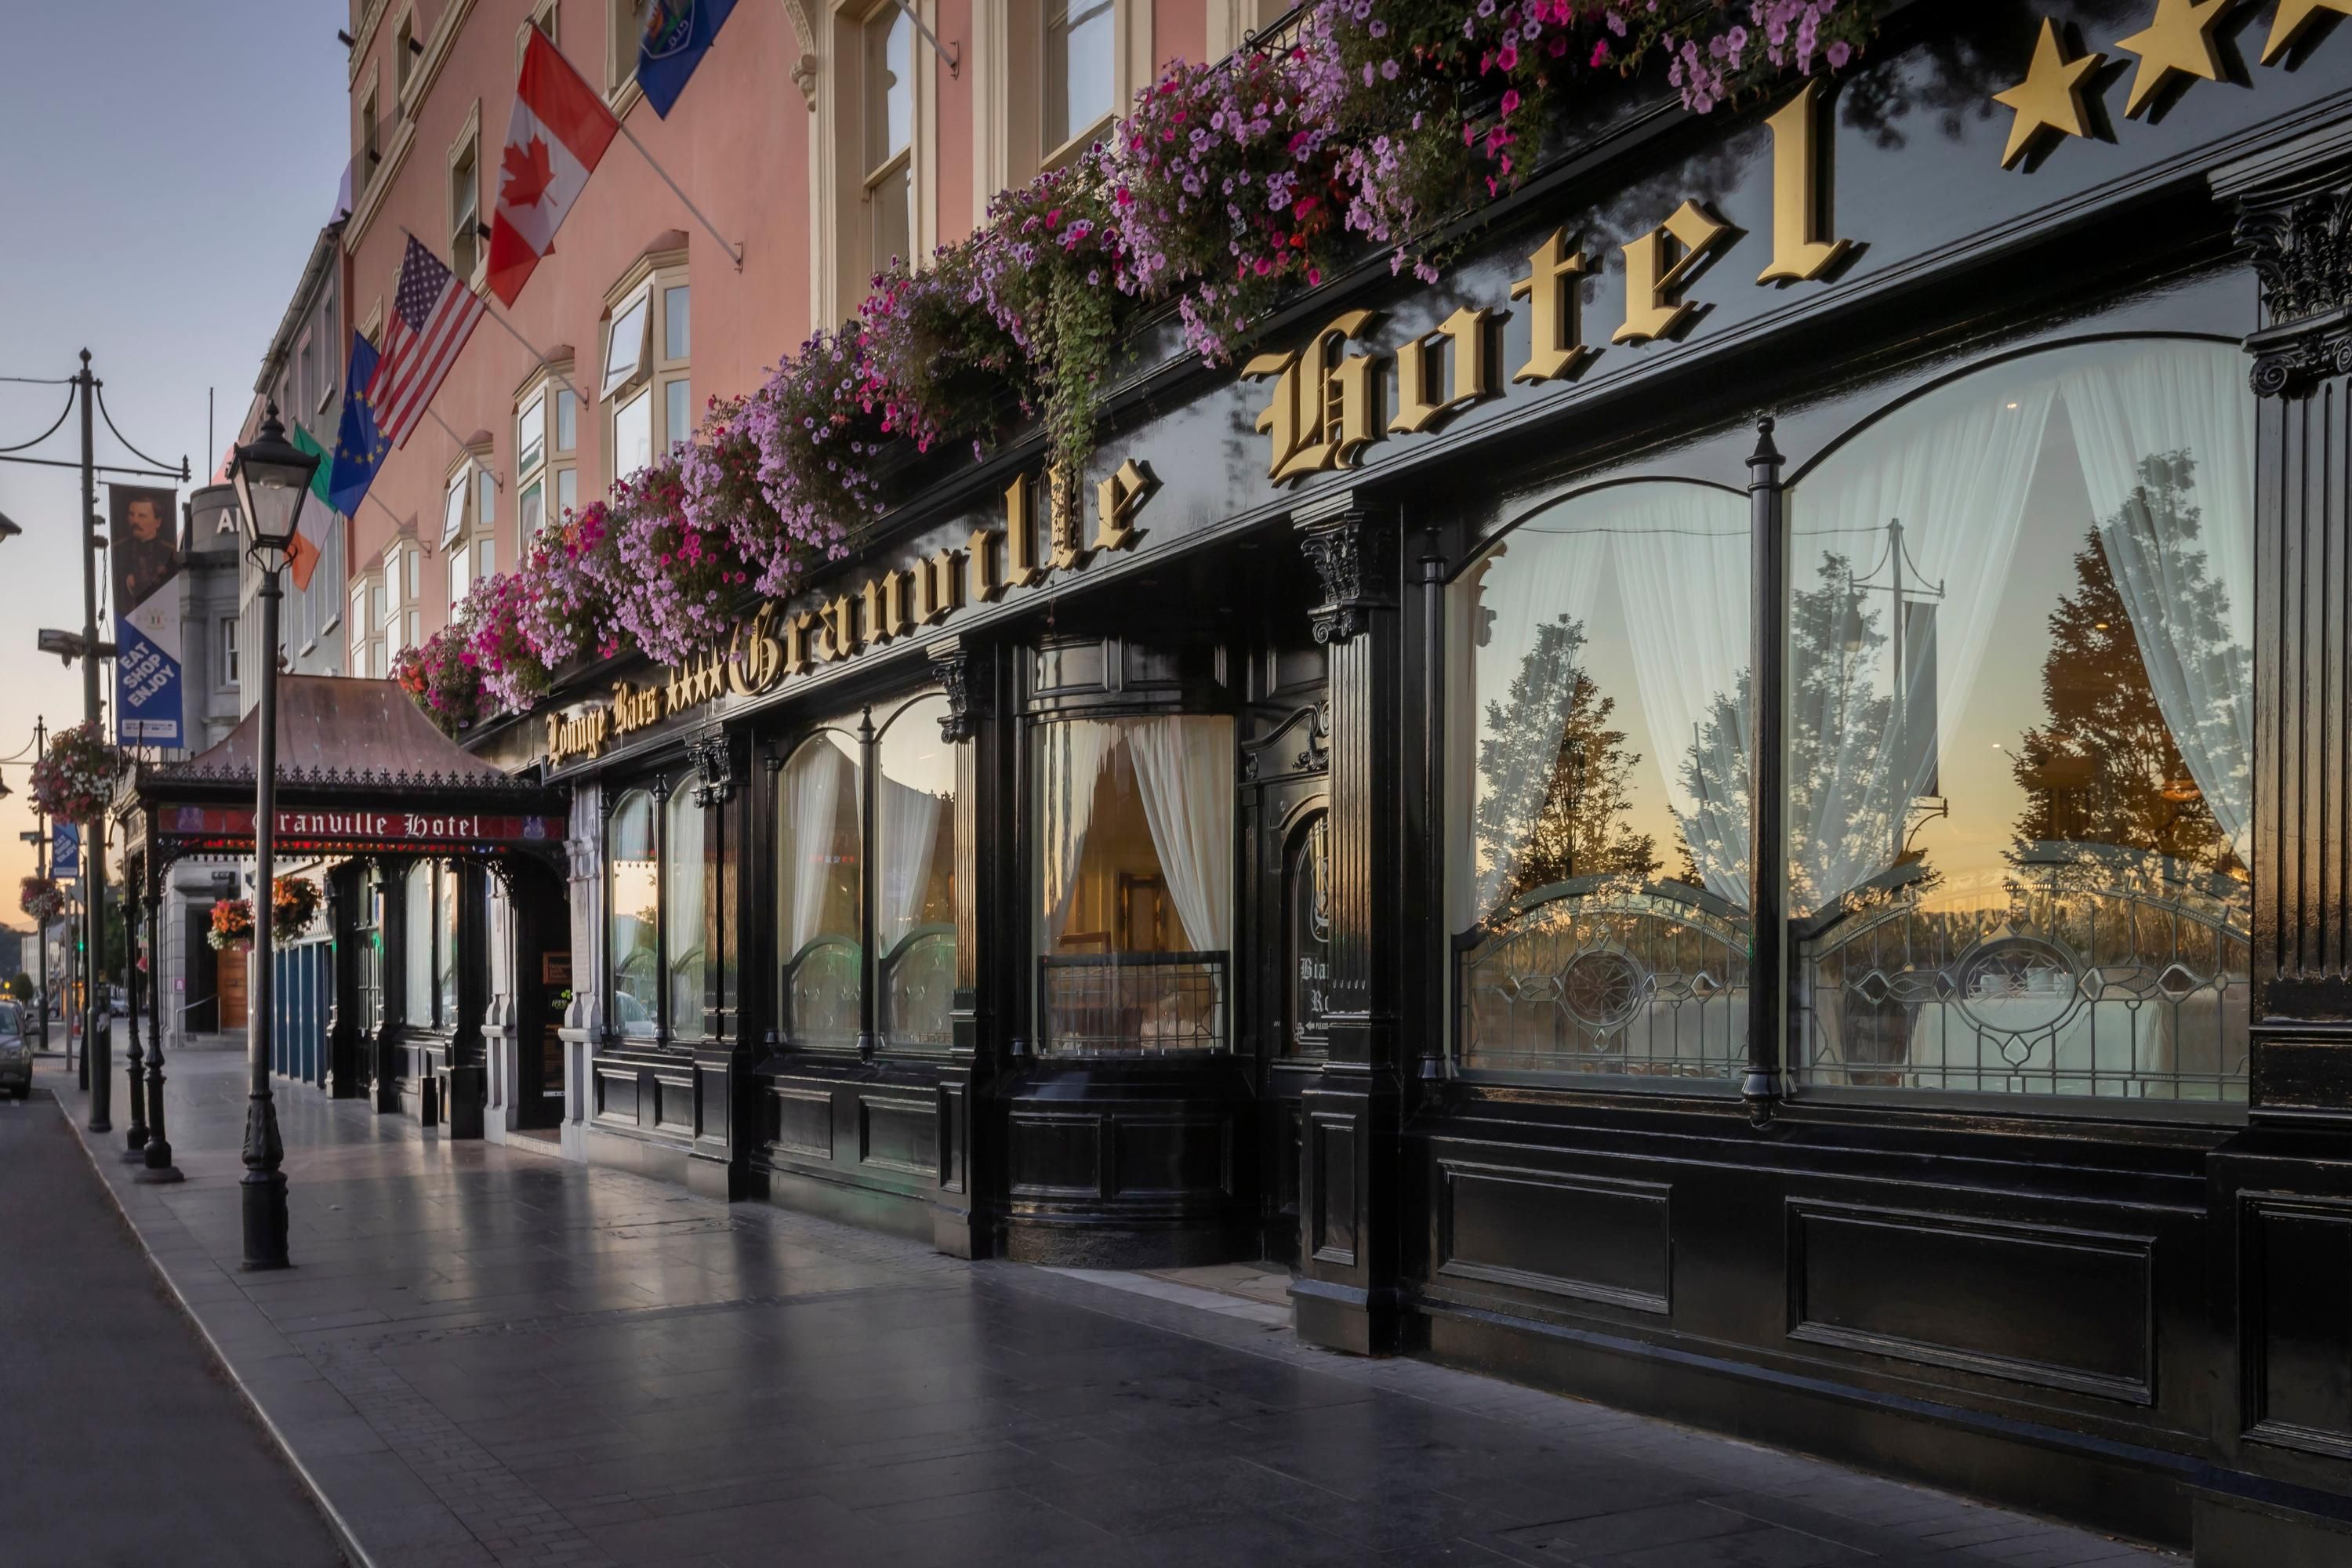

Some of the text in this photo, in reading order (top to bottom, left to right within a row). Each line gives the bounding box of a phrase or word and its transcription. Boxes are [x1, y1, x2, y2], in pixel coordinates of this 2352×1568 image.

[728, 78, 1855, 698] Granville Hotel
[119, 641, 150, 670] EAT
[123, 653, 162, 689] SHOP
[127, 664, 175, 708] ENJOY
[545, 679, 661, 768] Lounge Bars
[404, 812, 480, 840] Hotel
[1299, 956, 1329, 982] Bia
